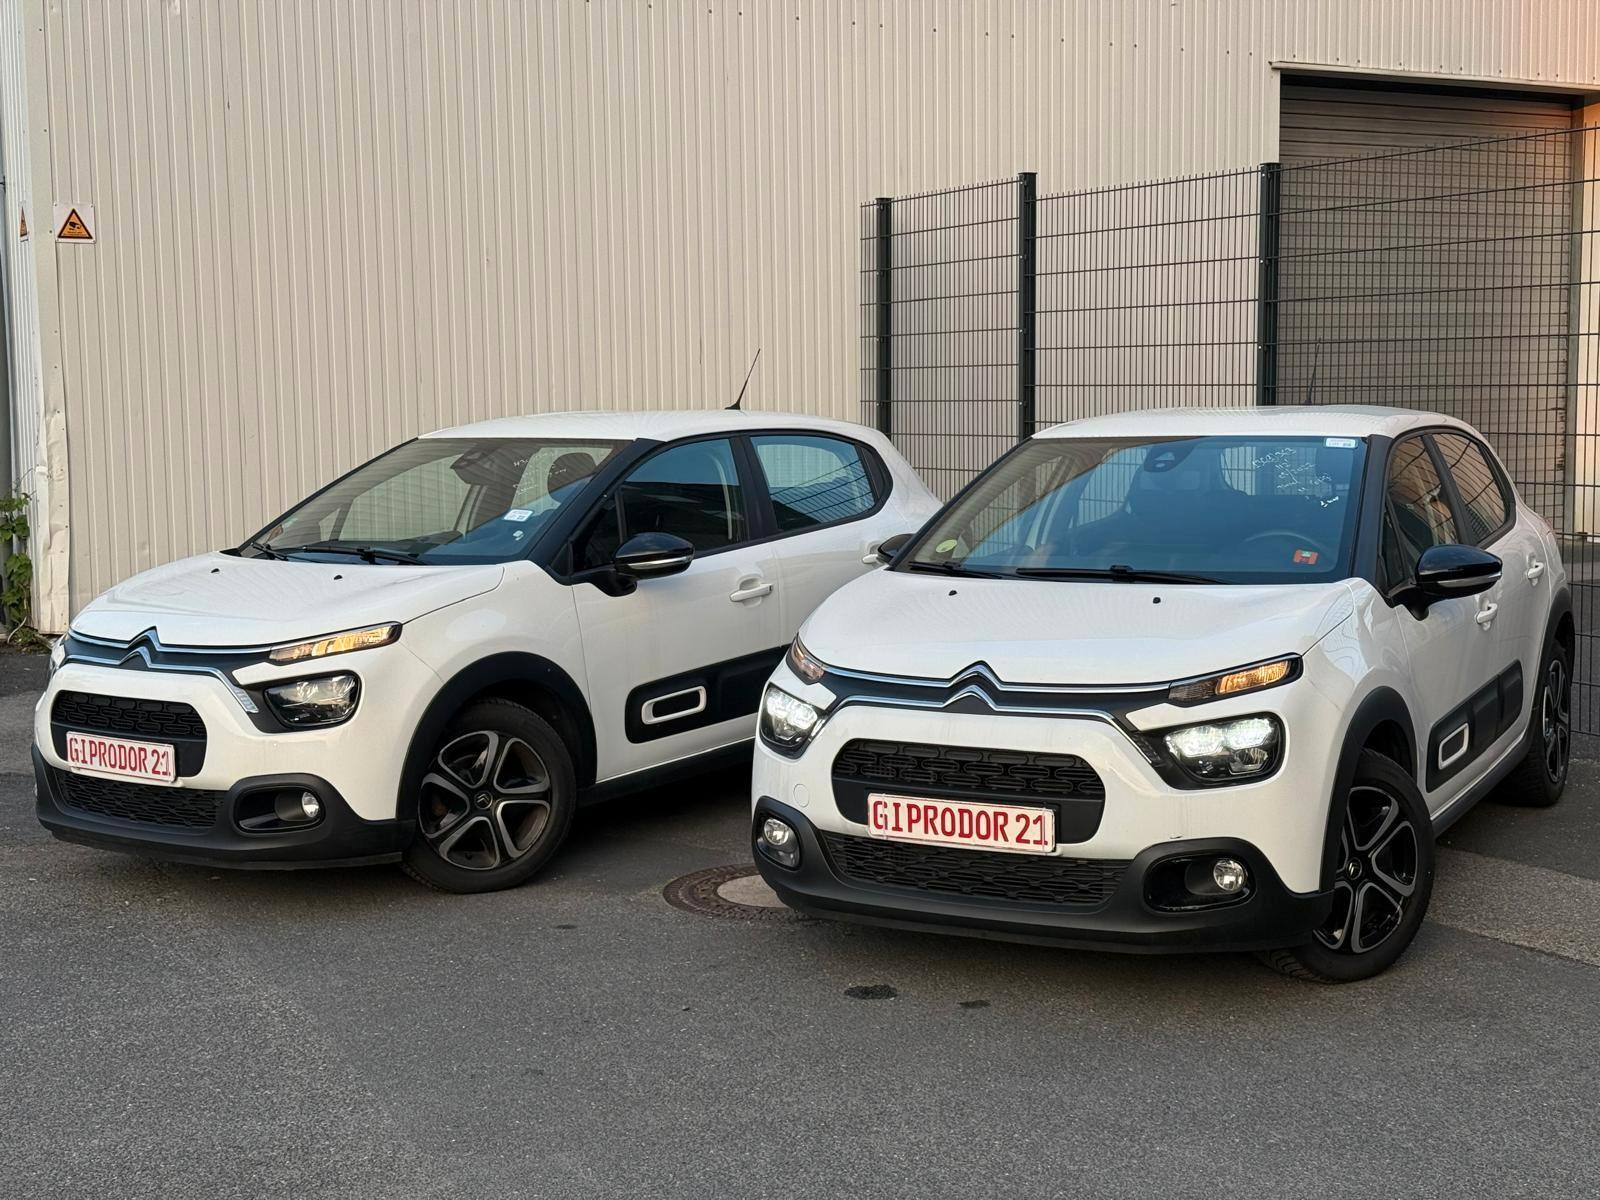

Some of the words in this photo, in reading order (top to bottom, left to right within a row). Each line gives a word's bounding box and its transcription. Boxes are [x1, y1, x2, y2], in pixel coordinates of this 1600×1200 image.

[69, 738, 148, 773] GIPRODOR
[151, 749, 171, 776] 21
[873, 801, 1009, 842] GIPRODOR
[1015, 813, 1048, 846] 21
